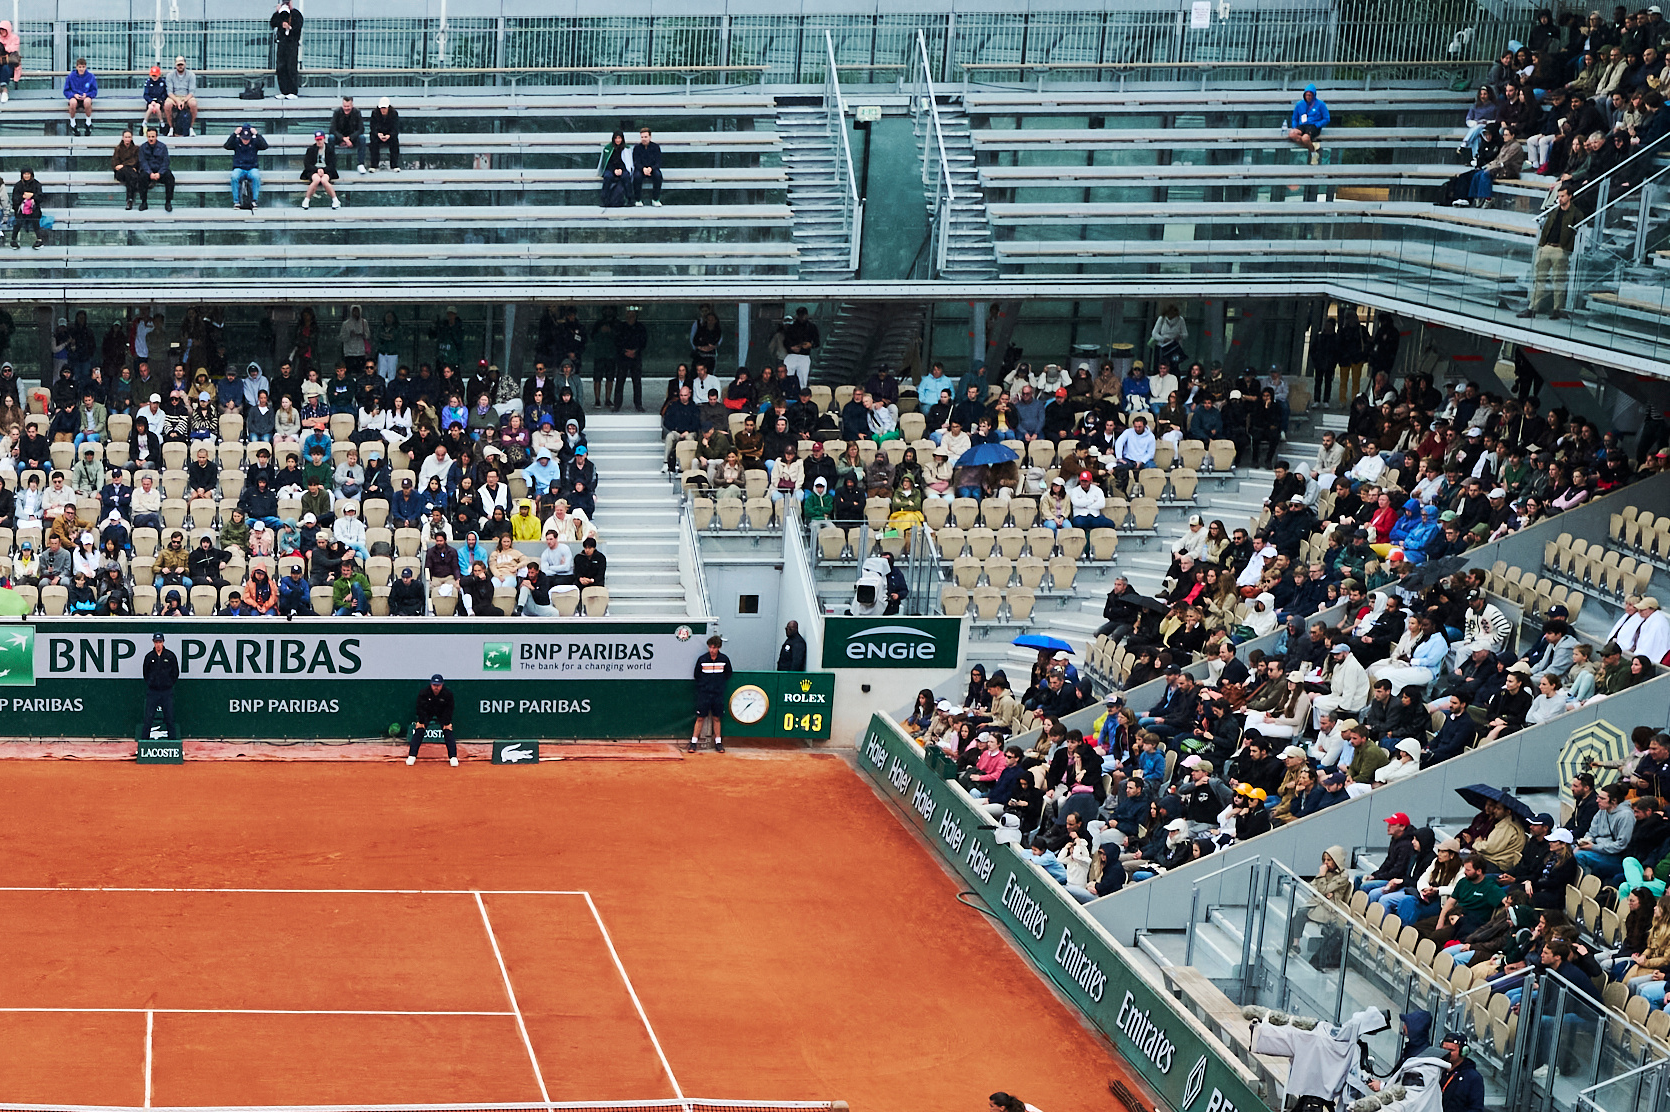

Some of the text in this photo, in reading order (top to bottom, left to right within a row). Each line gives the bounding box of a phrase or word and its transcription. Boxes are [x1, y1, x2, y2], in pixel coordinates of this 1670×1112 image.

[49, 638, 362, 674] BNP PARIBAS
[520, 643, 654, 660] BNP PARIBAS
[520, 662, 535, 670] The
[538, 662, 559, 670] bank
[561, 662, 574, 671] for
[585, 662, 624, 672] changing
[627, 662, 652, 670] world
[13, 698, 84, 712] PARIBAS
[230, 699, 339, 713] BNP PARIBAS
[480, 699, 591, 713] BNP PARIBAS
[784, 693, 826, 703] ROLEX
[783, 713, 823, 731] 0:43
[141, 748, 179, 758] LACOSTE
[866, 732, 889, 771] Haier
[888, 755, 912, 795] Haier
[911, 780, 937, 823] Haier
[938, 808, 967, 853] Haier
[966, 837, 996, 884] Haier
[1001, 871, 1049, 941] Emirates
[1054, 926, 1108, 1003] Emirates
[1116, 990, 1177, 1075] Emirates
